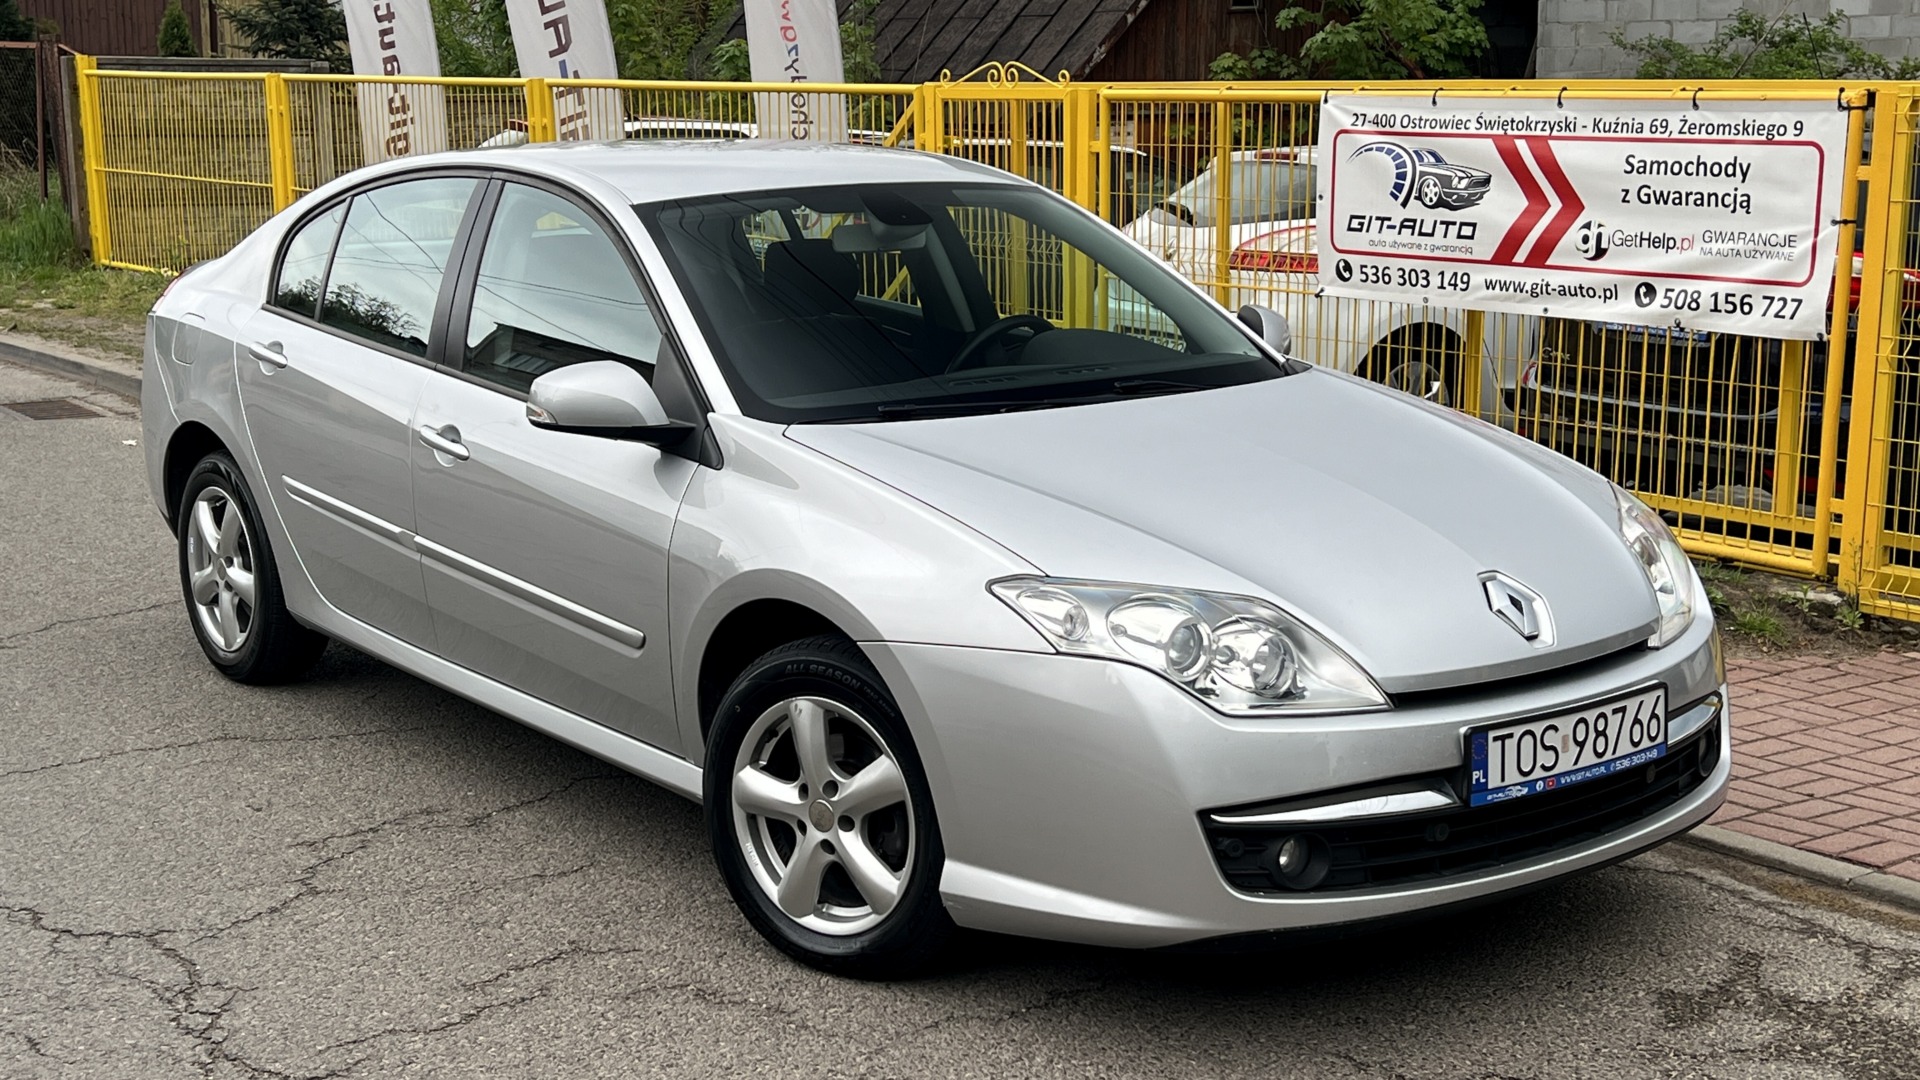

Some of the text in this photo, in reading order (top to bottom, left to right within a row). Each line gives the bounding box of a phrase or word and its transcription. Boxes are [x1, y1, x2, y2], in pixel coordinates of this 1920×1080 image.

[1350, 112, 1397, 129] 27-400
[1400, 114, 1472, 130] Ostrowiec
[1474, 111, 1577, 137] Świętokrzyski
[1592, 116, 1644, 134] Kuźnia
[1649, 118, 1673, 138] 69,
[1678, 114, 1788, 141] Żeromskiego
[1793, 120, 1804, 137] 9
[1623, 153, 1752, 184] Samochody
[1621, 184, 1752, 215] z Gwarancją
[1346, 214, 1478, 240] GIT-AUTO
[1702, 229, 1798, 249] GWARANCJE
[1368, 239, 1387, 248] auta
[1388, 240, 1423, 250] używane
[1429, 243, 1474, 256] gwarancją
[1612, 229, 1695, 254] GetHelp.pl
[1699, 246, 1796, 262] NA AUTA UŻYWANE
[1359, 264, 1471, 292] 536 303 149
[1484, 278, 1619, 303] www.git-auto.pl
[1660, 288, 1803, 320] 508 156 727
[1492, 694, 1662, 783] TOS 98766
[1472, 769, 1486, 785] PL
